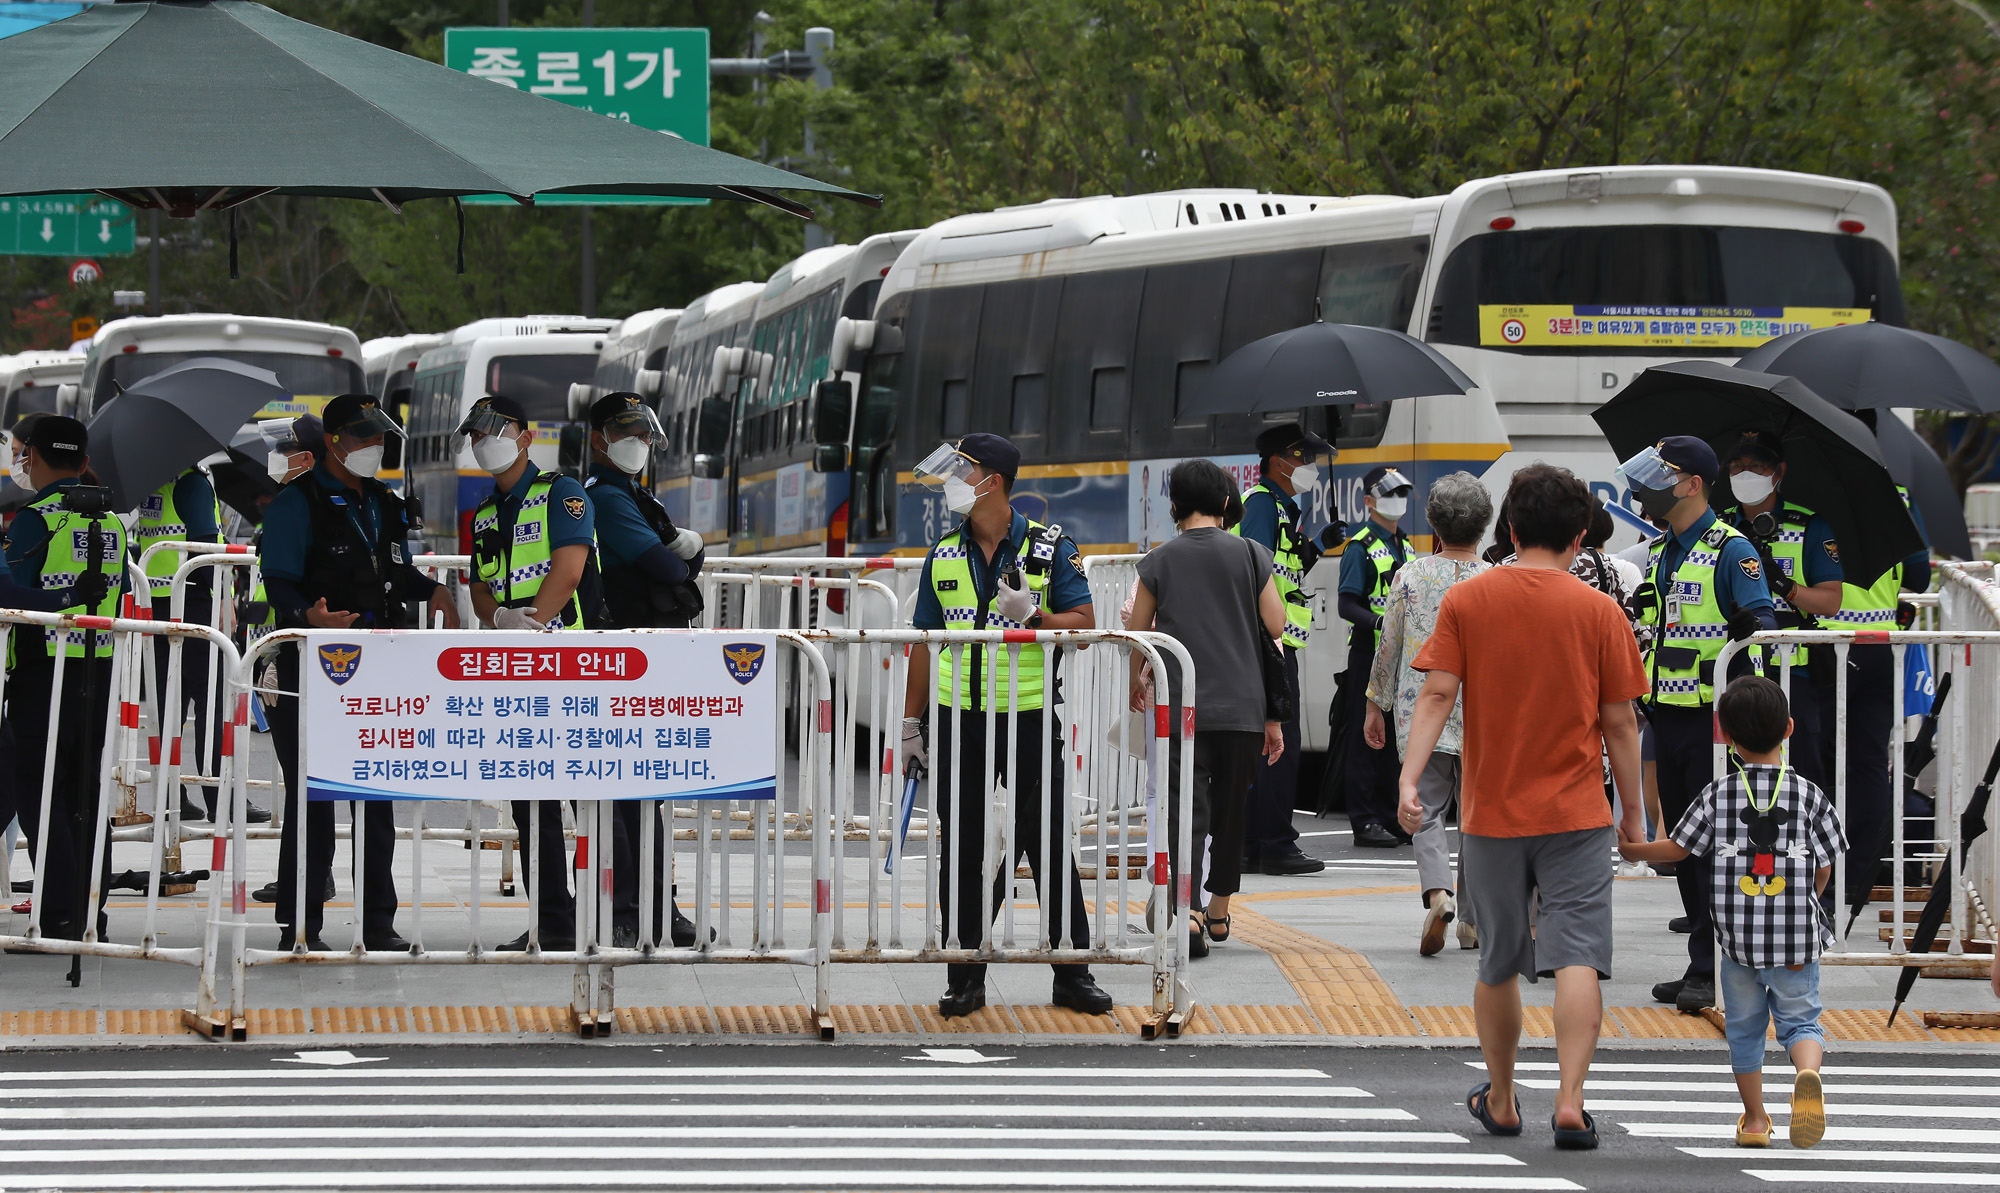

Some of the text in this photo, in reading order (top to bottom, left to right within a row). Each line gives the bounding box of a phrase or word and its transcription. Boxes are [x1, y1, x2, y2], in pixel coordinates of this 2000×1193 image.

[467, 47, 682, 98] 종로1가
[1507, 326, 1521, 337] 50
[1548, 317, 1594, 336] 3분!만
[1597, 320, 1646, 336] 여유있게
[1649, 320, 1697, 336] 출발하면
[1700, 321, 1737, 336] 모두가
[1316, 389, 1358, 397] Crocodile
[1313, 477, 1372, 524] POLIC
[517, 522, 540, 536] 경찰
[516, 534, 540, 543] POLICE
[77, 551, 115, 560] POCE
[1677, 582, 1700, 595] 경찰
[1679, 594, 1699, 602] OLICE
[459, 652, 626, 677] 집회금지 안내
[445, 696, 484, 717] 확산
[493, 696, 550, 717] 방지를
[561, 696, 599, 717] 위해
[609, 696, 744, 717] 감염병예방법과
[358, 727, 712, 749] 집시법에 따라 서울시·경찰에서 집회를
[352, 759, 716, 781] 금지하였으니 협조하여 주시기 바랍니다.
